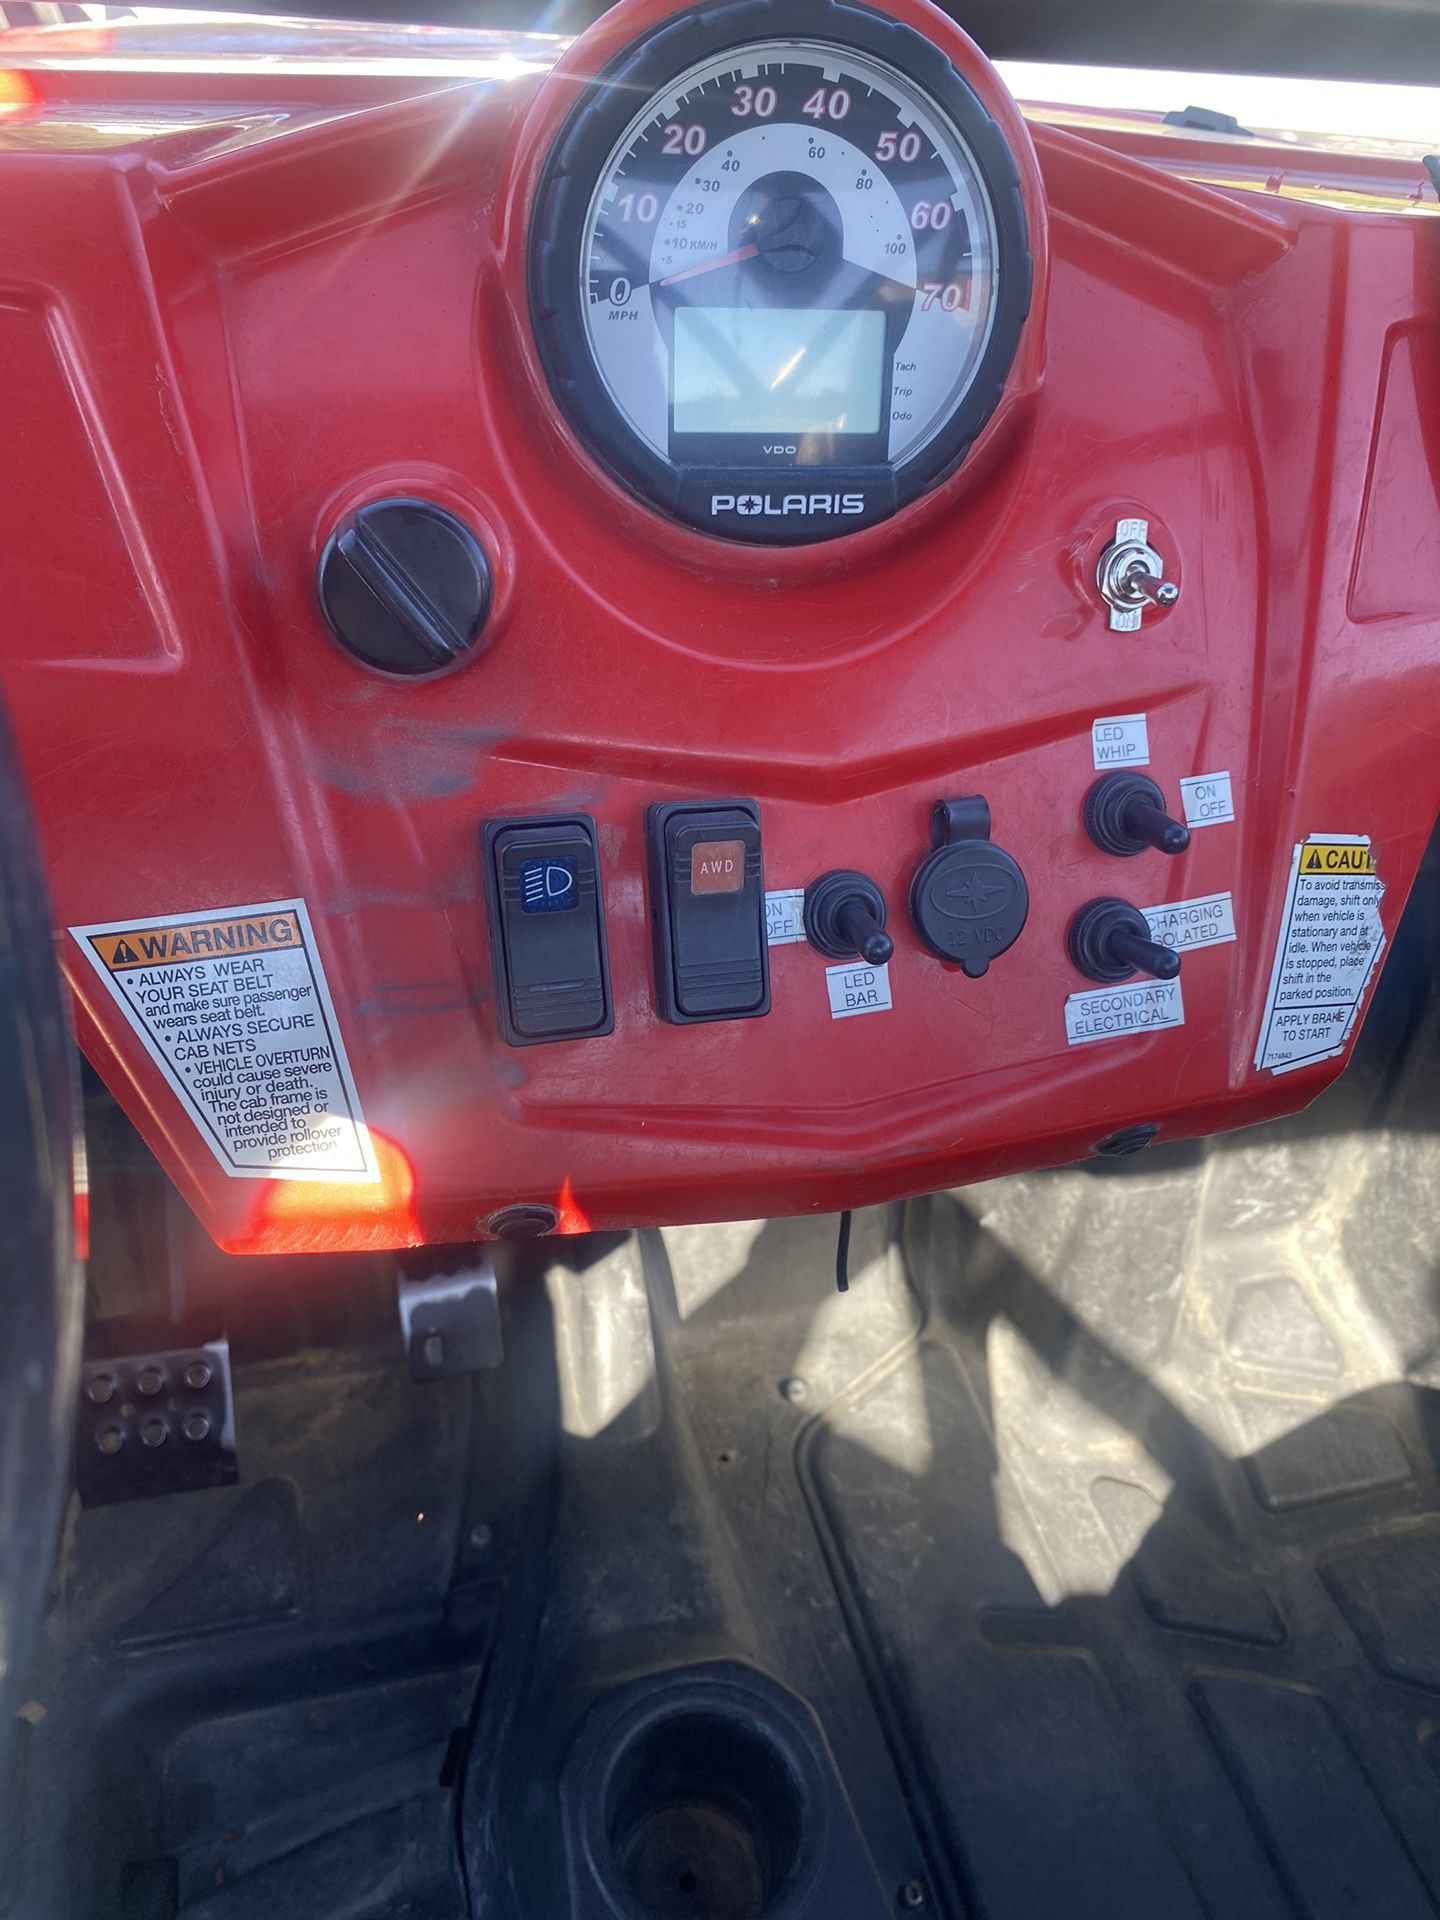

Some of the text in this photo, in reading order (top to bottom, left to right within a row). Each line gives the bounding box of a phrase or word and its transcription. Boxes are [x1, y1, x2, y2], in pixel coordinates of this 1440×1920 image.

[731, 85, 778, 118] 30
[802, 87, 851, 120] 40
[662, 124, 706, 155] 20
[875, 130, 921, 163] 50
[808, 146, 826, 160] 60
[721, 159, 740, 173] 40
[702, 179, 720, 193] 30
[855, 177, 873, 191] 80
[617, 193, 658, 222] 10
[686, 203, 704, 214] 20
[910, 200, 951, 231] 60
[676, 220, 687, 229] 15
[672, 238, 718, 250] 10 KM/H
[884, 242, 906, 255] 100
[666, 256, 672, 264] 5
[609, 277, 631, 306] 0
[920, 282, 961, 313] 70
[608, 310, 638, 321] MPH
[895, 361, 917, 371] Tach
[893, 387, 912, 397] Trip
[892, 411, 912, 420] Odo
[762, 446, 797, 455] VDO
[711, 494, 864, 515] POLARIS
[1120, 521, 1146, 536] OFF
[1096, 727, 1124, 742] LED
[1097, 744, 1136, 759] WHIP
[1195, 785, 1216, 799] ON
[1200, 800, 1226, 817] OFF
[700, 860, 734, 874] AWD
[1300, 879, 1312, 890] To
[1315, 880, 1340, 890] avoid
[1297, 895, 1380, 908] damage, shift only
[1295, 911, 1365, 922] when vehicle is
[139, 918, 293, 959] WARNING
[1151, 923, 1218, 946] SOLATED
[1292, 926, 1369, 939] stationary and at
[1288, 941, 1371, 954] idle. When vehicle
[1286, 956, 1365, 970] is stopped, place
[139, 958, 265, 987] ALWAYS WEAR
[844, 971, 875, 989] LED
[1283, 972, 1332, 985] shift in the
[136, 974, 273, 1004] YOUR SEAT BELT
[1279, 987, 1354, 1002] parked position.
[145, 985, 313, 1017] and make sure passenger
[846, 990, 878, 1007] BAR
[1080, 988, 1175, 1016] SECONDARY
[153, 1005, 265, 1030] wears seat belt.
[1075, 1008, 1169, 1034] ELECTRICAL
[1275, 1010, 1345, 1027] APPLY BRAKE
[176, 1013, 315, 1044] ALWAYS SECURE
[1283, 1027, 1331, 1041] TO START
[174, 1038, 257, 1061] CAB NETS
[195, 1046, 331, 1076] VEHICLE OVERTURN
[193, 1061, 332, 1089] could cause severe
[201, 1077, 313, 1101] injury or death.
[208, 1088, 328, 1113] The cab frame is
[218, 1101, 329, 1126] not designed or
[225, 1117, 306, 1138] intended to
[234, 1126, 342, 1152] provide rollover
[267, 1139, 338, 1161] protection
